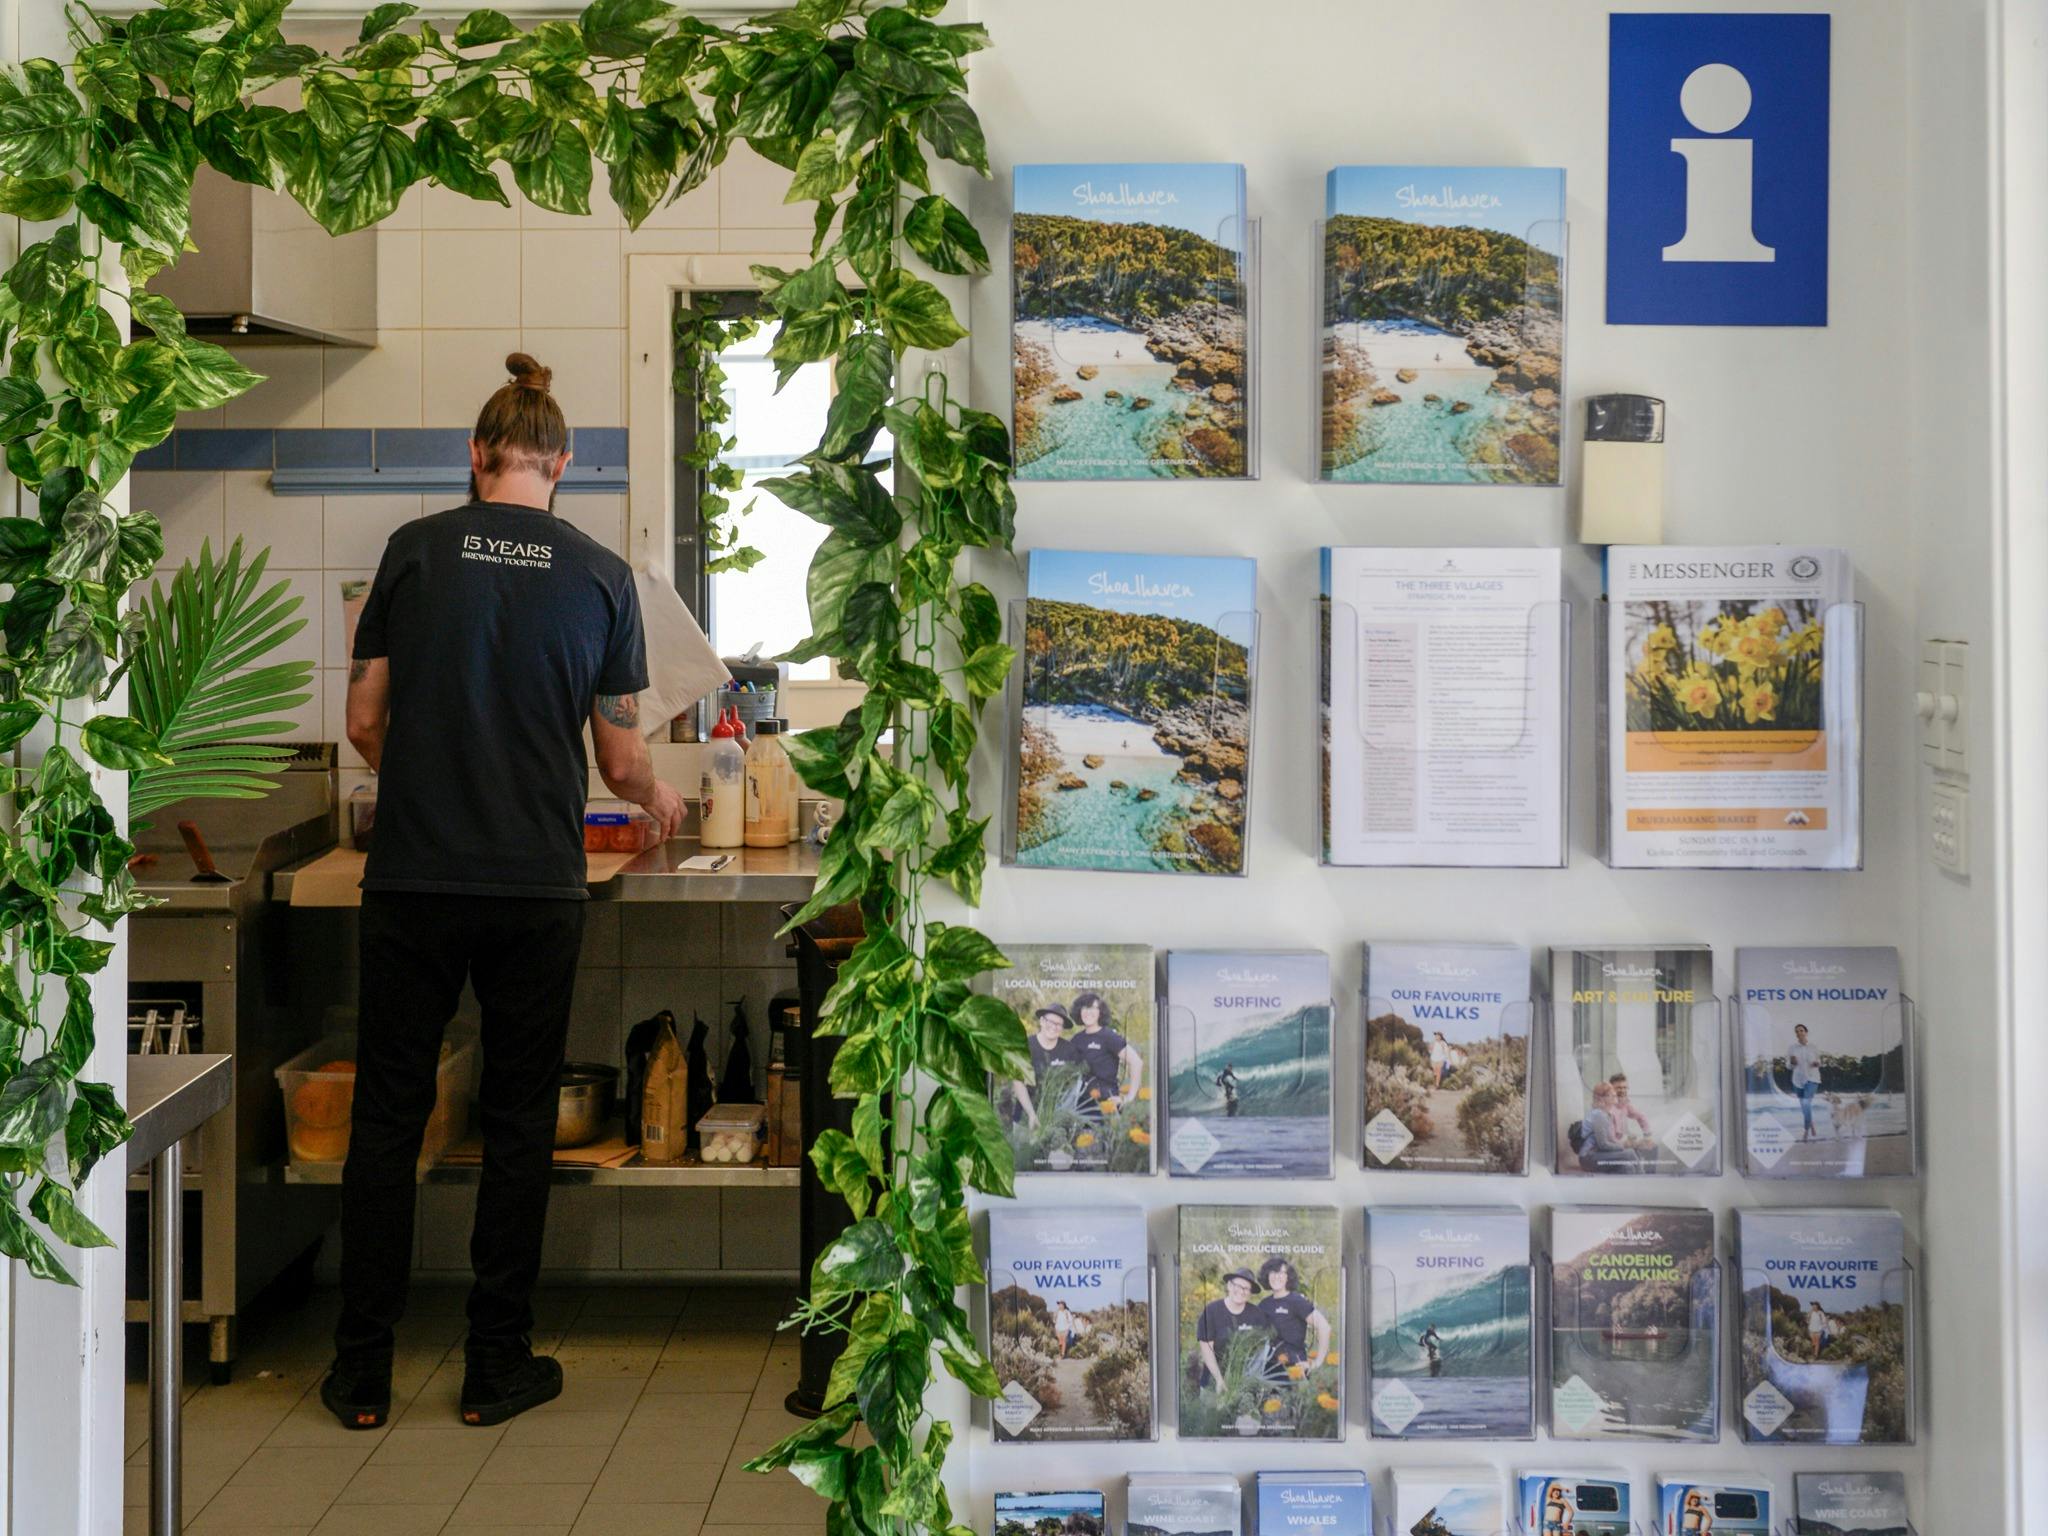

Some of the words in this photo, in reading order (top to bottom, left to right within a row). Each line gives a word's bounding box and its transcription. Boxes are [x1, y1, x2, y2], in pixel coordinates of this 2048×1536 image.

[1072, 181, 1179, 207] Shoalhaven
[1395, 184, 1502, 209] Shoalhaven
[463, 535, 482, 550] 15
[486, 538, 552, 559] YEARS
[461, 551, 502, 564] BREWING
[503, 557, 551, 569] TOGETHER
[1642, 562, 1775, 580] MESSENGER
[1087, 571, 1195, 598] Shoalhaven
[1395, 580, 1416, 591] THE
[1418, 580, 1452, 591] THREE
[1454, 580, 1504, 591] VILLAGES
[1005, 979, 1037, 989] LOCAL
[1040, 979, 1103, 989] PRODUCERS
[1104, 980, 1137, 989] GUIDE
[1391, 989, 1421, 1001] OUR
[1424, 990, 1503, 1003] FAVOURITE
[1572, 990, 1604, 1003] ART
[1607, 990, 1617, 1003] &
[1746, 989, 1786, 1001] PETS
[1789, 989, 1813, 1000] ON
[1817, 988, 1888, 1001] HOLIDAY
[1213, 996, 1282, 1008] SURFING
[1413, 1004, 1480, 1020] WALKS
[1192, 1244, 1225, 1253] LOCAL
[1228, 1244, 1291, 1254] PRODUCERS
[1292, 1245, 1325, 1254] GUIDE
[1012, 1260, 1042, 1271] OUR
[1046, 1259, 1123, 1271] FAVOURITE
[1416, 1256, 1485, 1268] SURFING
[1588, 1254, 1674, 1267] CANOEING
[1765, 1259, 1796, 1271] OUR
[1799, 1260, 1879, 1271] FAVOURITE
[1583, 1268, 1594, 1281] &
[1597, 1268, 1681, 1281] KAYAKING
[1034, 1274, 1102, 1289] WALKS
[1787, 1275, 1857, 1289] WALKS
[1280, 1488, 1343, 1504] Shoalhaven
[1143, 1514, 1177, 1524] WINE
[1286, 1515, 1337, 1525] WHALES
[1815, 1508, 1848, 1519] WINE
[1848, 1508, 1889, 1519] COAST
